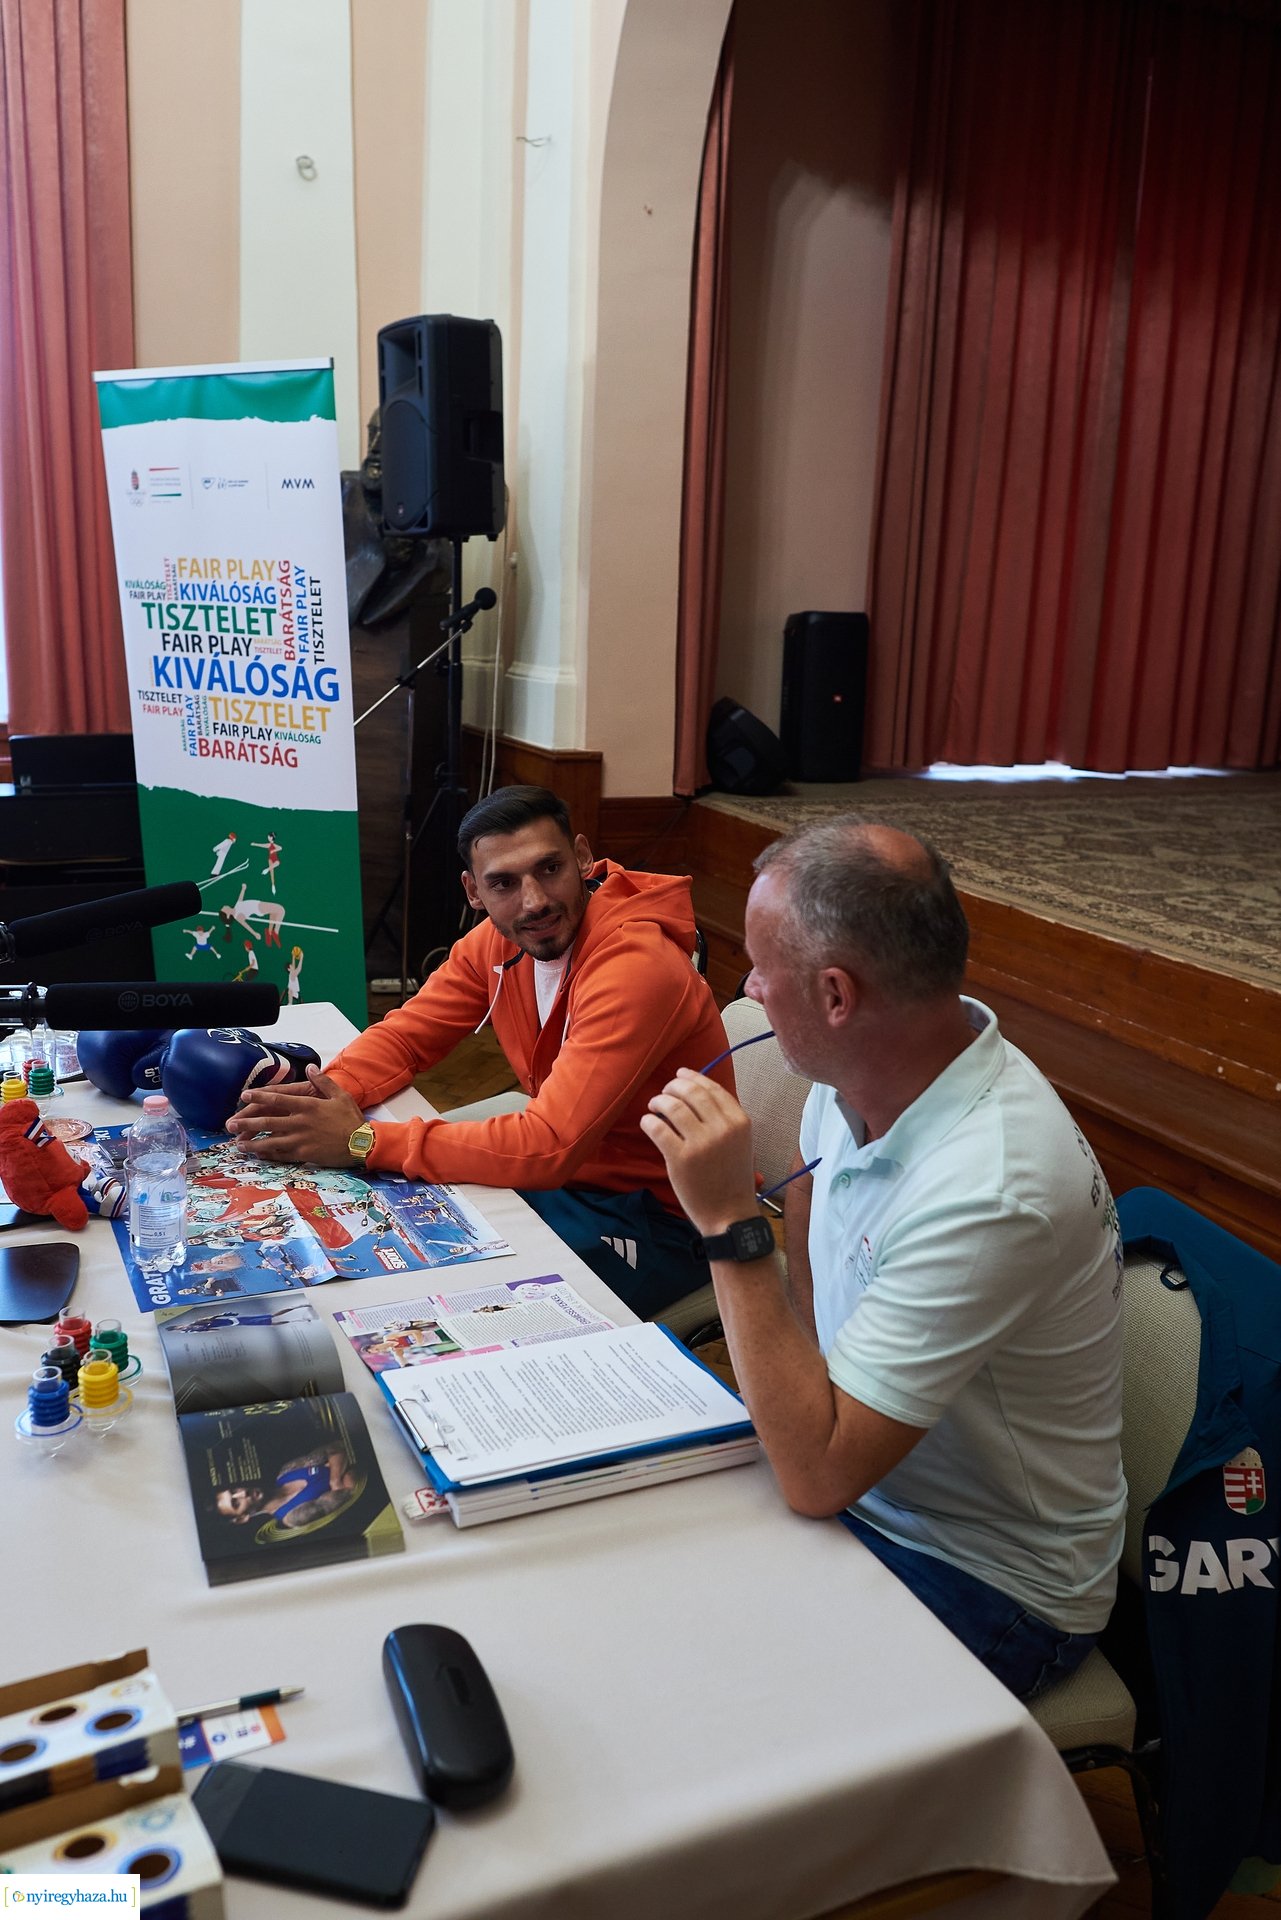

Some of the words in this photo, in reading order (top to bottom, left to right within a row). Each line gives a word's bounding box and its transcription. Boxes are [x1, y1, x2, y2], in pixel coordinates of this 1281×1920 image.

[281, 478, 315, 490] MVM
[164, 558, 173, 600] TISZTELET
[177, 558, 222, 579] FAIR
[227, 559, 275, 581] PLAY
[125, 579, 166, 591] KIVÁLÓSÁG
[129, 590, 145, 600] FAIR
[147, 591, 166, 601] PLAY
[179, 580, 277, 605] KIVÁLÓSÁG
[294, 566, 307, 609] PLAY
[141, 602, 277, 636] TISZTELET
[277, 560, 296, 660] BARÁTSÁG
[310, 576, 325, 664] TISZTELET
[162, 633, 203, 653] FAIR
[208, 635, 252, 657] PLAY
[297, 615, 309, 653] FAIR
[153, 652, 340, 702] KIVÁLÓSÁG
[138, 690, 182, 704] TISZTELET
[143, 704, 160, 714] FAIR
[162, 706, 184, 717] PLAY
[185, 695, 196, 726] PLAY
[208, 696, 332, 732] TISZTELET
[188, 730, 198, 757] FAIR
[213, 722, 239, 737] FAIR
[242, 726, 273, 741] PLAY
[274, 731, 322, 744] KIVÁLÓSÁG
[198, 738, 298, 768] BARÁTSÁG
[104, 921, 143, 937] BOYA
[142, 993, 193, 1007] BOYA
[1148, 1535, 1280, 1595] GAR
